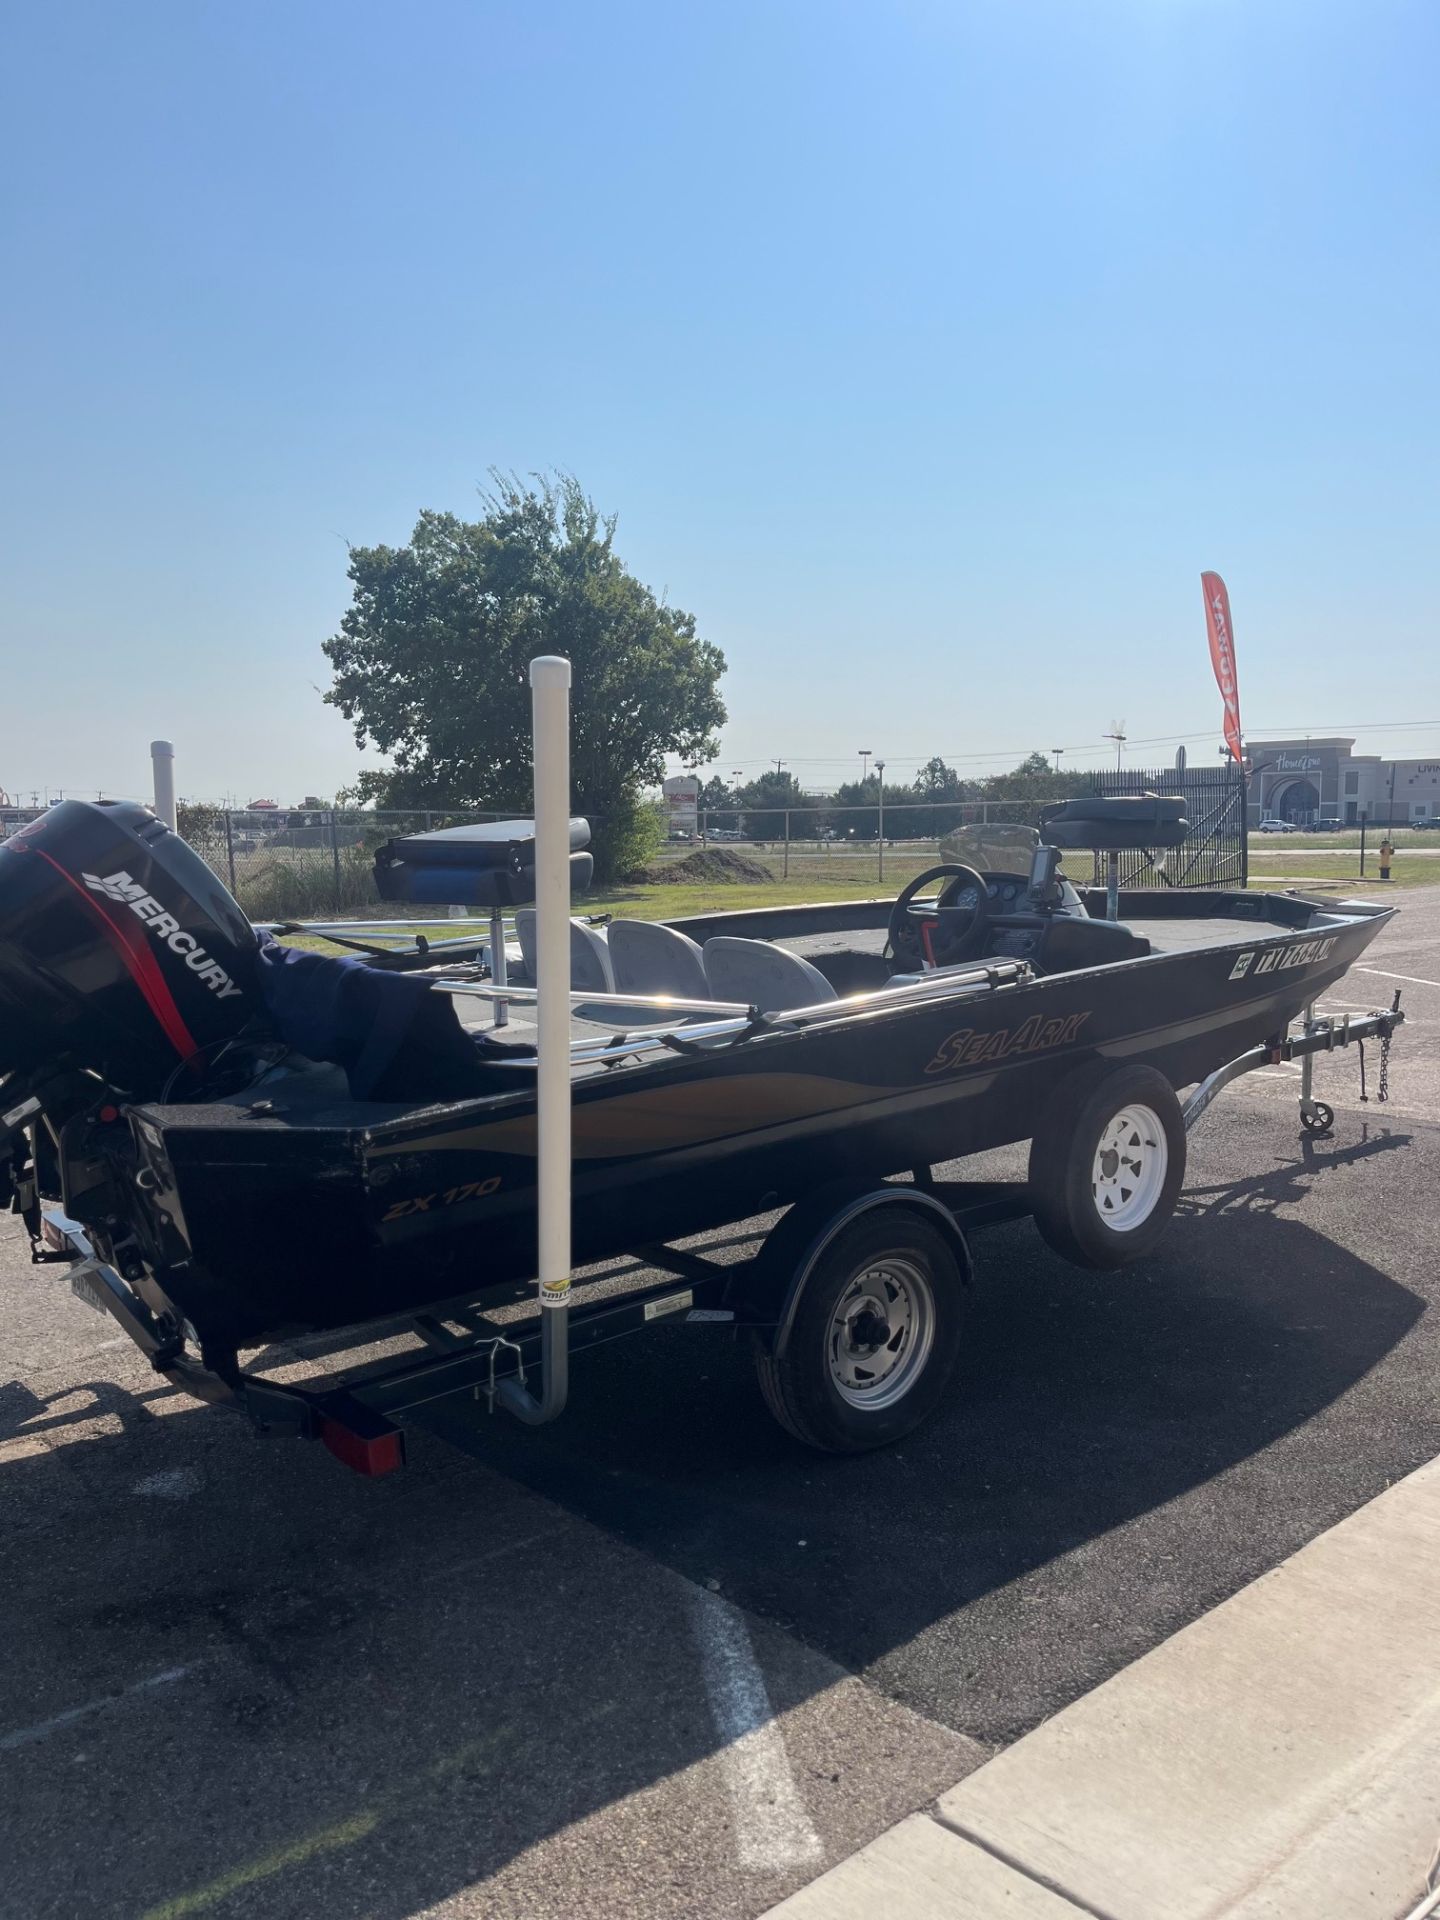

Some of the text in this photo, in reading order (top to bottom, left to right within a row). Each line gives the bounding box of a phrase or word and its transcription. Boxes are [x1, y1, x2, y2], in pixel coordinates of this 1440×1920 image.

[82, 870, 243, 999] MERCURY
[1257, 948, 1284, 973] TX
[382, 1176, 502, 1222] ZX 170
